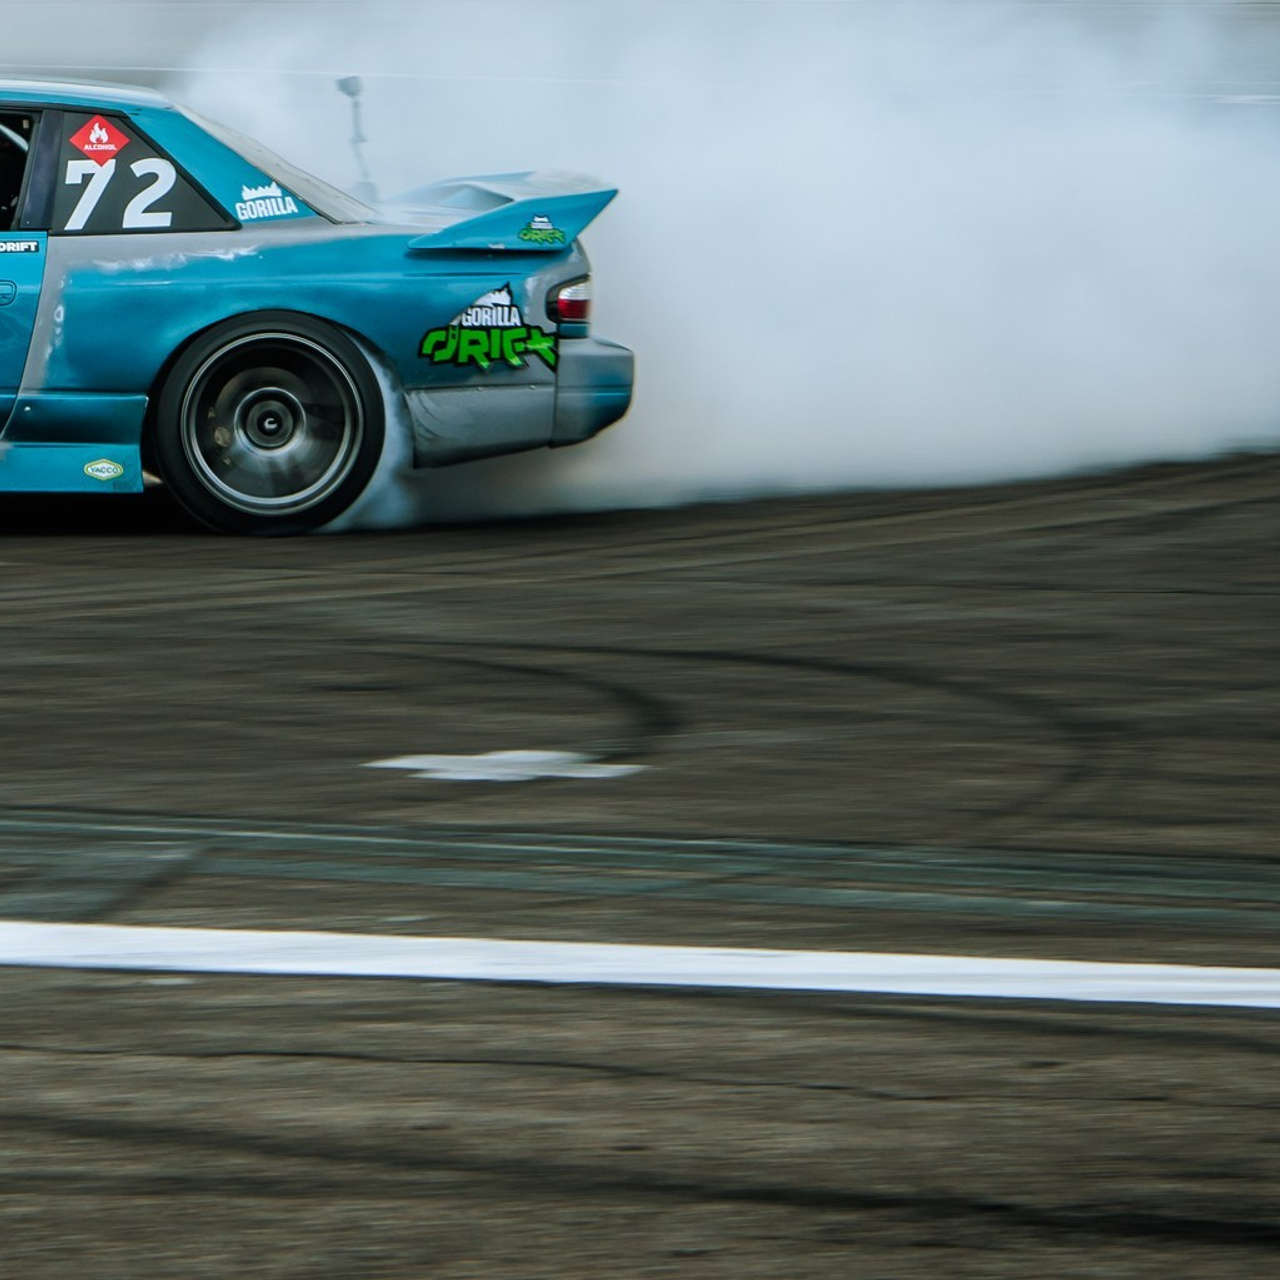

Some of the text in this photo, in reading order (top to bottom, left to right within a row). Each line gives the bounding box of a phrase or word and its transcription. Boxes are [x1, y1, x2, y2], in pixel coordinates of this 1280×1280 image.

[83, 143, 118, 151] ALCOHOL
[64, 157, 176, 231] 72
[235, 196, 299, 220] GORILLA
[461, 305, 522, 327] GORILLA
